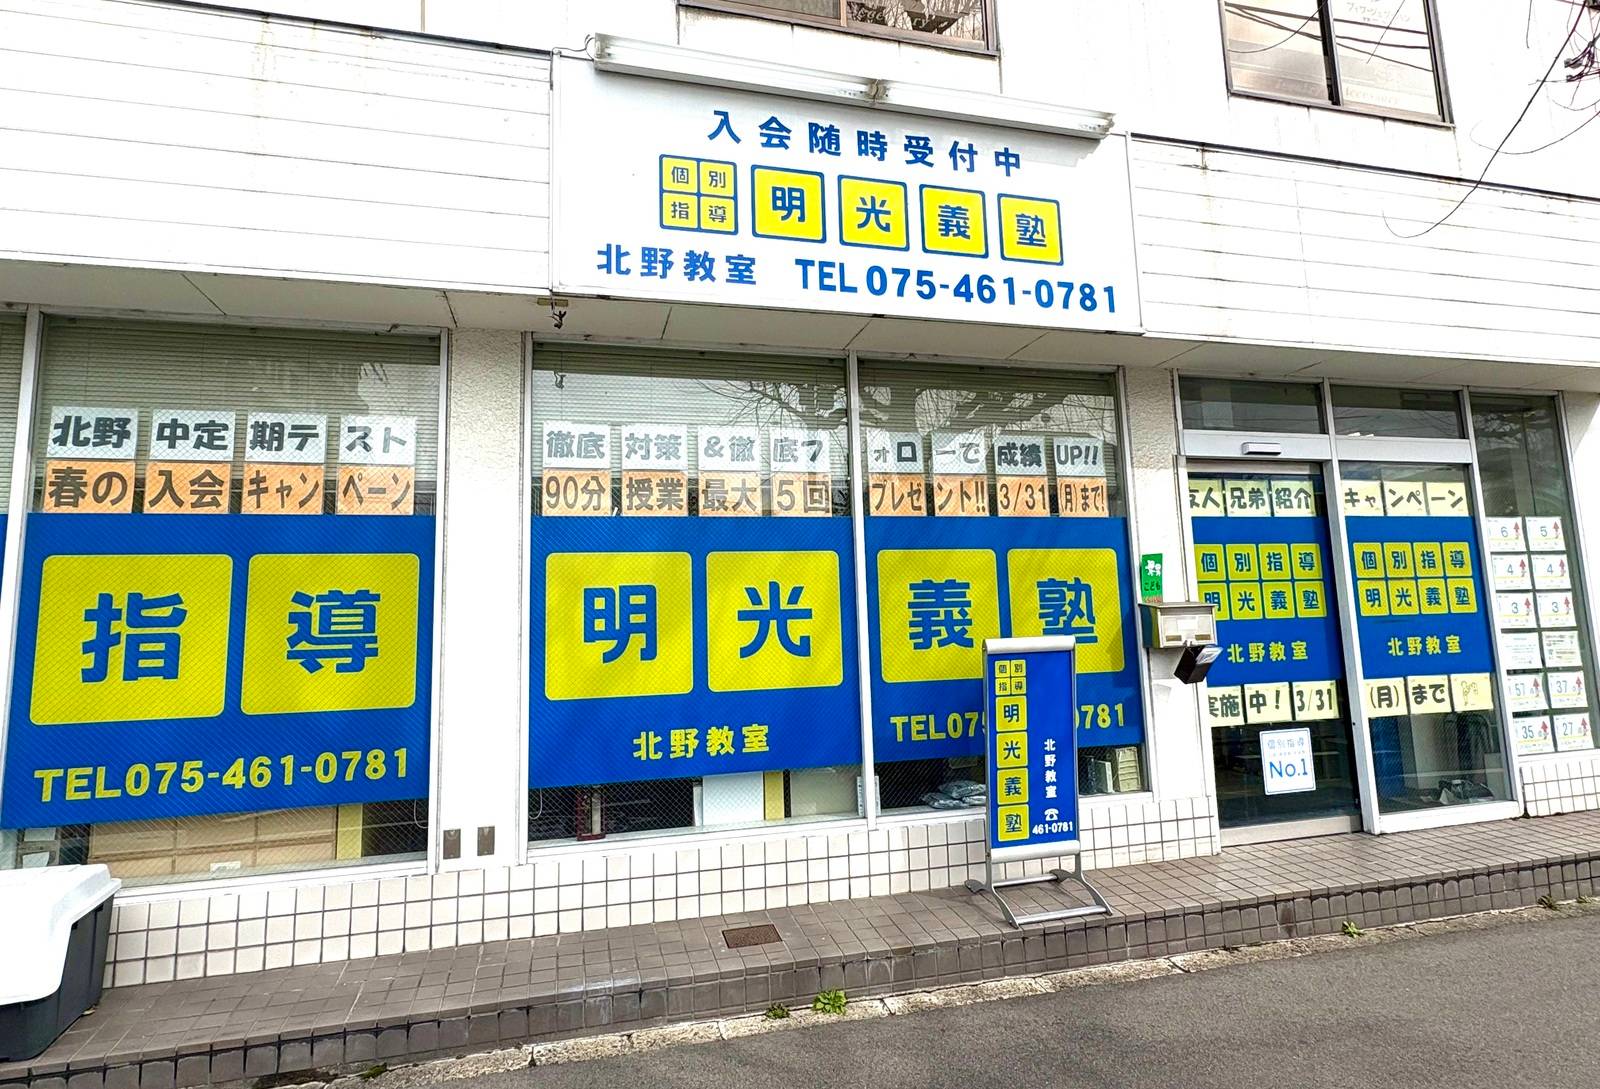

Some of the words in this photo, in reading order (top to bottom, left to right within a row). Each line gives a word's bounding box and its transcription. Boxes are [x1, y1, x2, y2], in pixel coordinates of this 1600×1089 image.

[708, 110, 1021, 177] 入会随時受付中
[671, 166, 727, 189] 個別
[671, 202, 728, 224] 指導
[772, 186, 1048, 249] 明光義塾
[597, 243, 757, 286] 北野教室
[795, 258, 858, 294] TEL
[867, 265, 1116, 313] 075-461-0781
[1201, 552, 1323, 573] 個別指導
[1361, 550, 1466, 570] 個別指導
[1366, 587, 1470, 607] 明光義塾
[583, 580, 813, 664] 明光
[907, 577, 1098, 650] 義塾
[81, 589, 381, 684] 指導
[1388, 635, 1462, 656] 北野教室
[1227, 641, 1308, 664] 北野教室
[633, 724, 770, 761] 北野教室
[1003, 704, 1022, 833] 明光義塾
[1044, 738, 1057, 799] 北野教室
[1269, 757, 1309, 780] No.1
[1032, 820, 1074, 835] 461-0781
